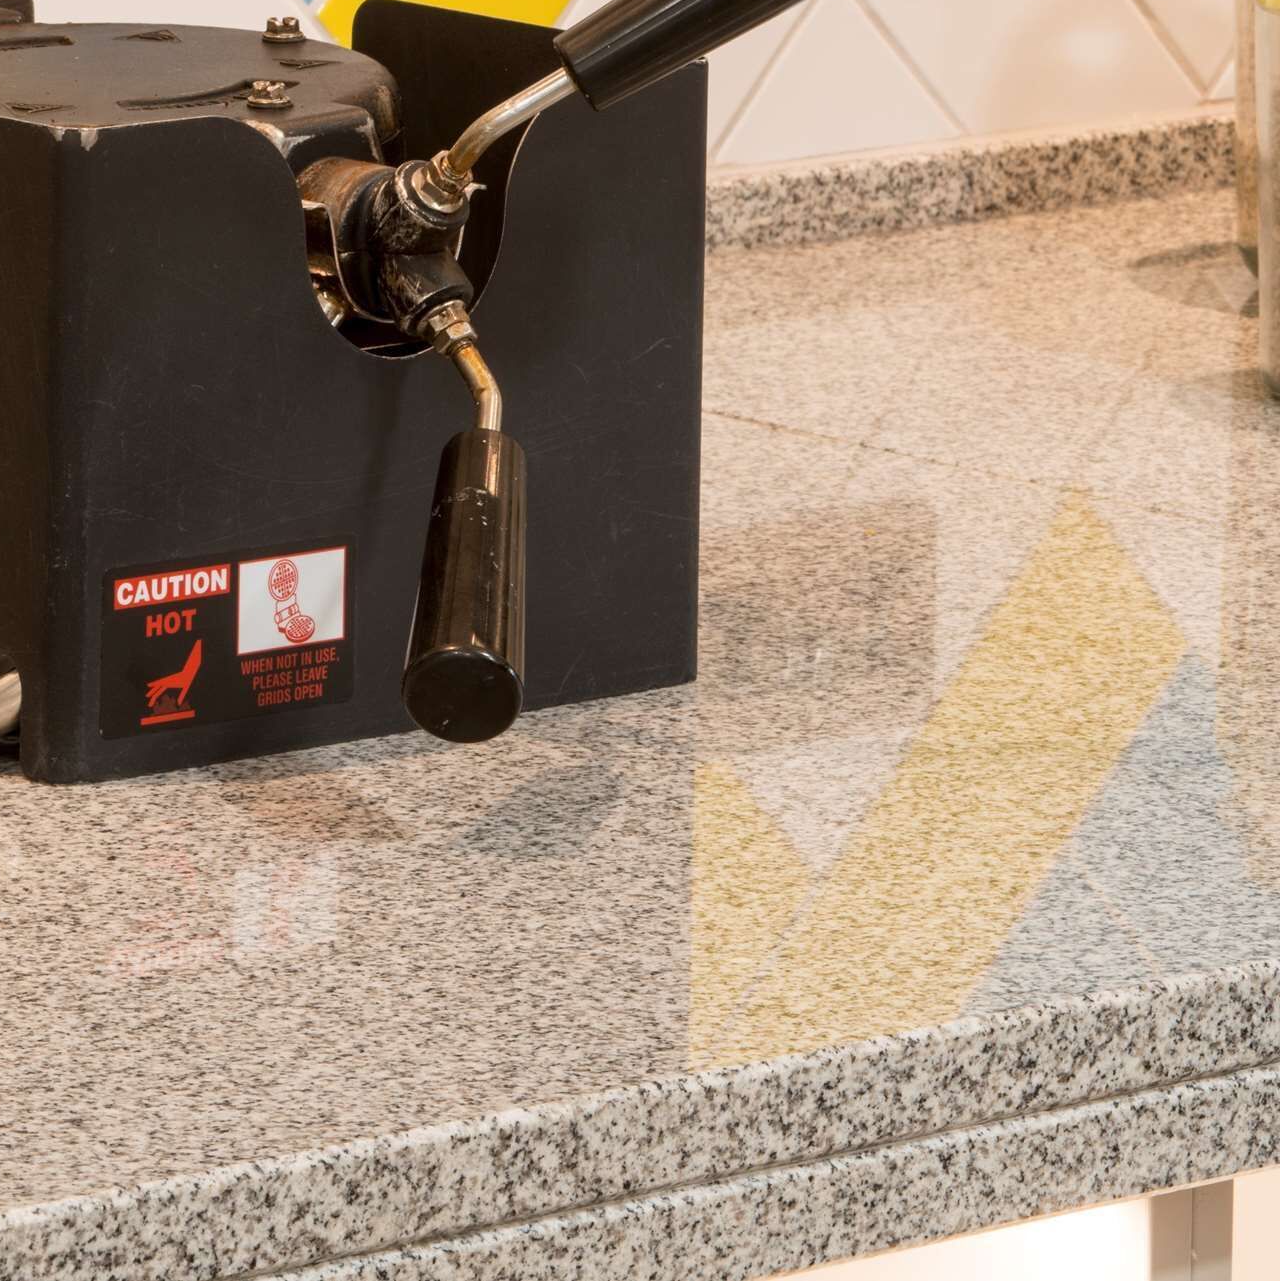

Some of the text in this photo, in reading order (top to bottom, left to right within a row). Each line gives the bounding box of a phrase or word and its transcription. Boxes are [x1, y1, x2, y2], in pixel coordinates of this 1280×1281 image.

[116, 568, 228, 606] CAUTION
[145, 609, 197, 638] HOT
[241, 656, 273, 675] WHEN
[276, 651, 298, 670] NOT
[300, 650, 313, 666] IN
[253, 665, 328, 690] PLEASE LEAVE
[258, 683, 323, 707] GRIDS OPEN
